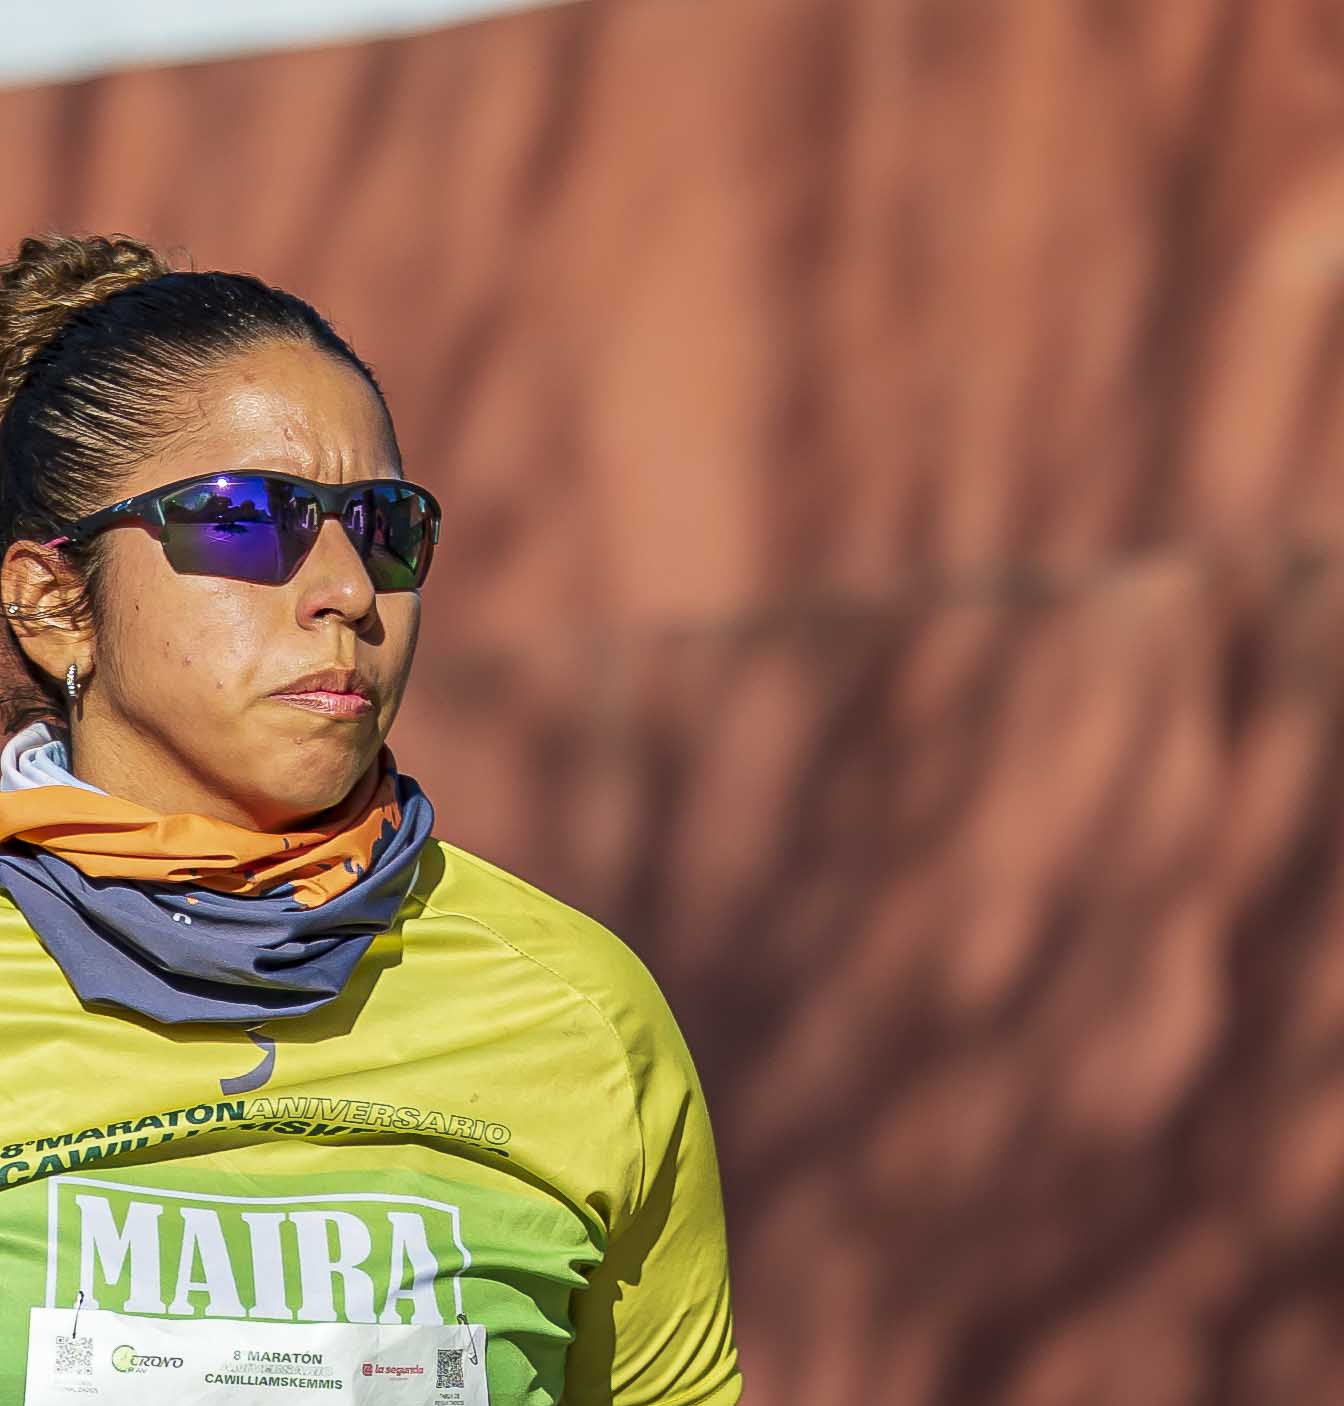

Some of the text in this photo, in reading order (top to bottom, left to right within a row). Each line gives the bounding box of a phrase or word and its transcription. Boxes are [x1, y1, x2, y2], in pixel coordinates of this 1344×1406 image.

[244, 1096, 511, 1145] ANIVERSARIO
[74, 1194, 444, 1326] MAIRA
[204, 1373, 343, 1390] CAWILLIAMSKEMMIS
